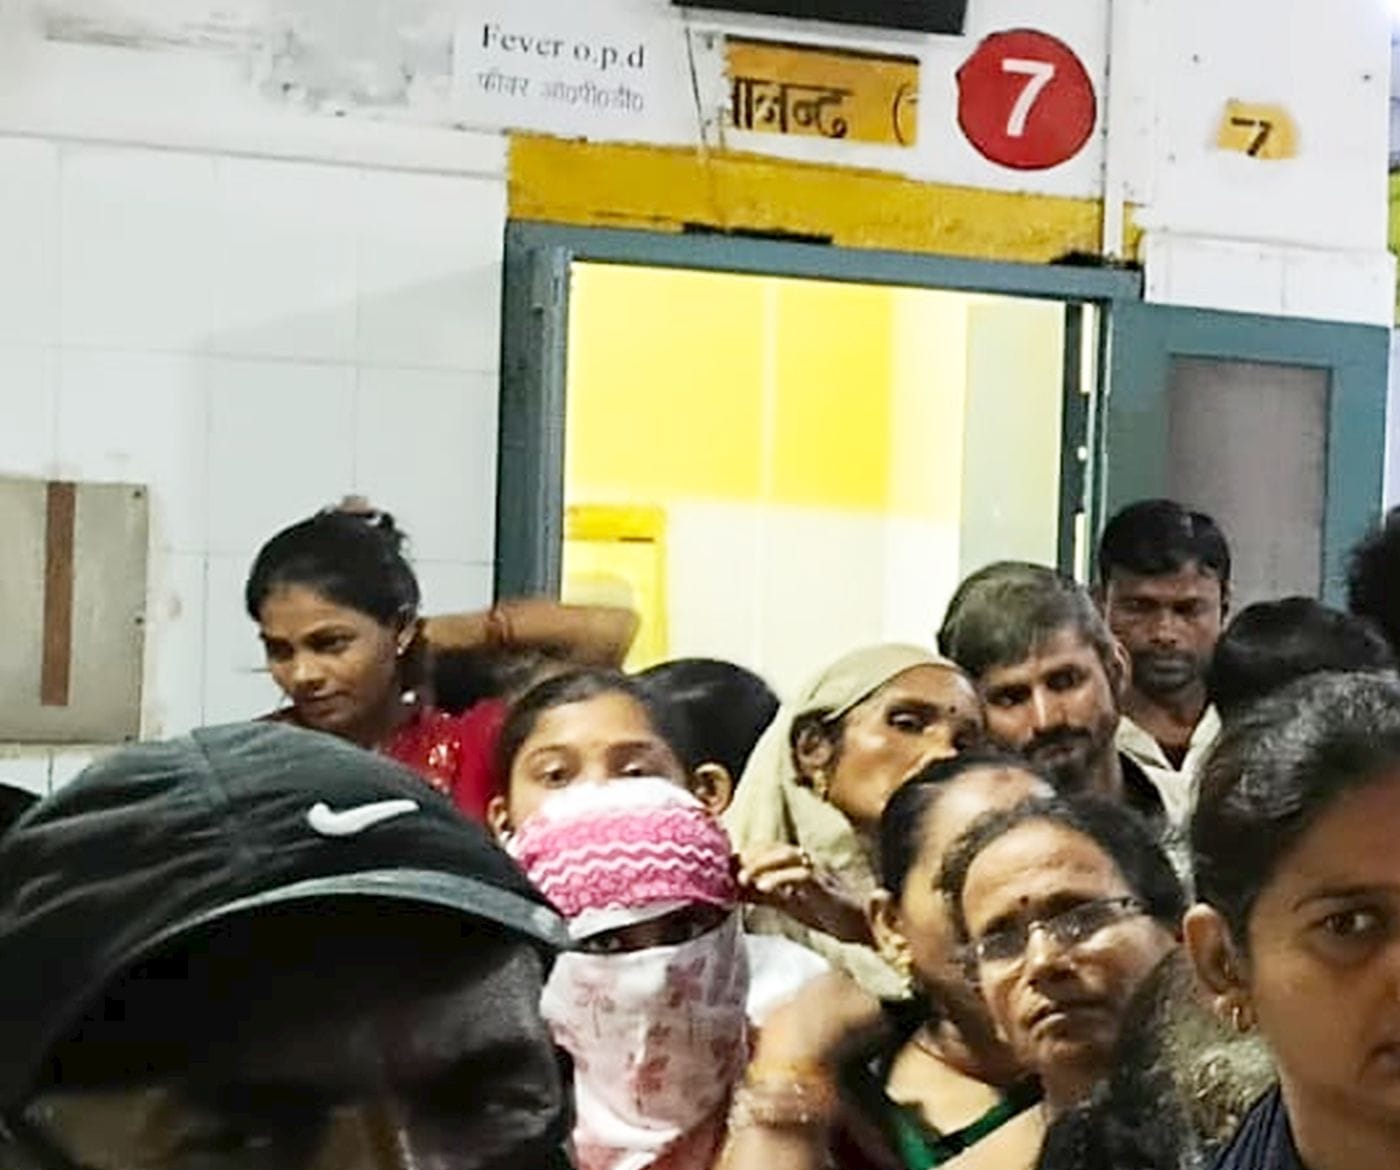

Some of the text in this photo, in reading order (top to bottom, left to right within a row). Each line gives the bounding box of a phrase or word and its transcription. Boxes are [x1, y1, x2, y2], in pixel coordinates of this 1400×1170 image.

[482, 23, 563, 57] Fever
[1002, 58, 1054, 137] 7
[1230, 117, 1272, 156] 7
